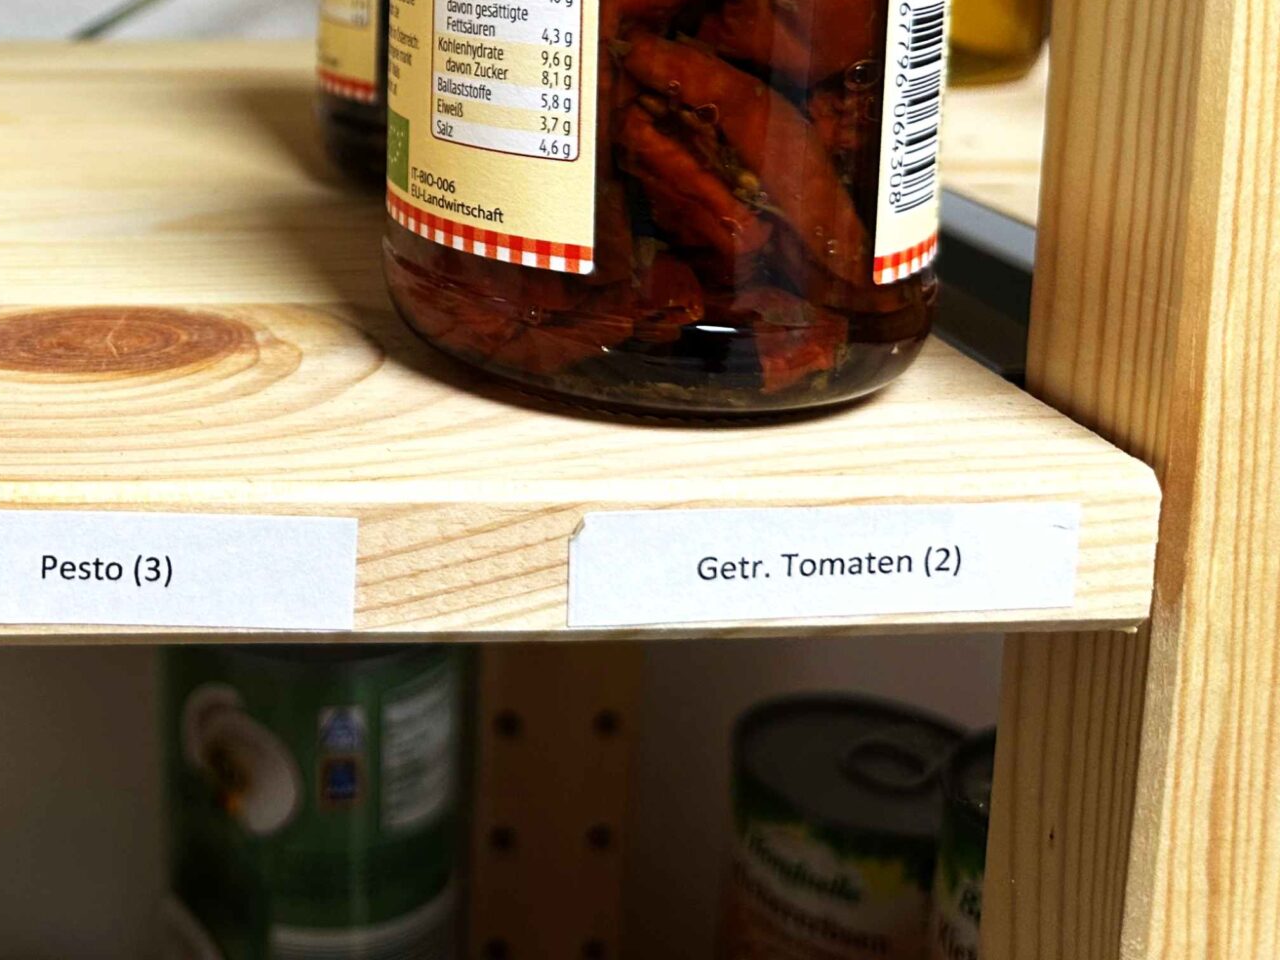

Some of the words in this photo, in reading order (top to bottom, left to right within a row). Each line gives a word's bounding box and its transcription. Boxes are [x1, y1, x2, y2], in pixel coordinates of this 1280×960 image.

[475, 3, 529, 23] gesättigte
[446, 16, 496, 37] Fettsäuren
[541, 28, 560, 45] 4,3
[564, 31, 573, 47] g
[438, 37, 504, 61] Kohlenhydrate
[445, 57, 471, 74] davon
[474, 61, 509, 80] Zucker
[541, 50, 560, 68] 9,6
[564, 54, 572, 70] g
[437, 77, 492, 101] Ballaststoffe
[541, 70, 559, 88] 8,1
[564, 74, 572, 90] g
[436, 98, 463, 118] Eiweiß
[541, 93, 559, 111] 5,8
[563, 97, 571, 113] g
[436, 120, 453, 137] Salz
[540, 116, 559, 133] 3,7
[562, 120, 571, 136] g
[539, 139, 558, 156] 4,6
[562, 142, 570, 159] g
[411, 167, 456, 194] IT-BIO-006
[411, 183, 504, 223] EU-Landwirtschaft
[41, 555, 123, 581] Pesto
[134, 554, 173, 588] (3)
[697, 556, 770, 580] Getr.
[780, 552, 913, 577] Tomaten
[923, 545, 962, 577] (2)
